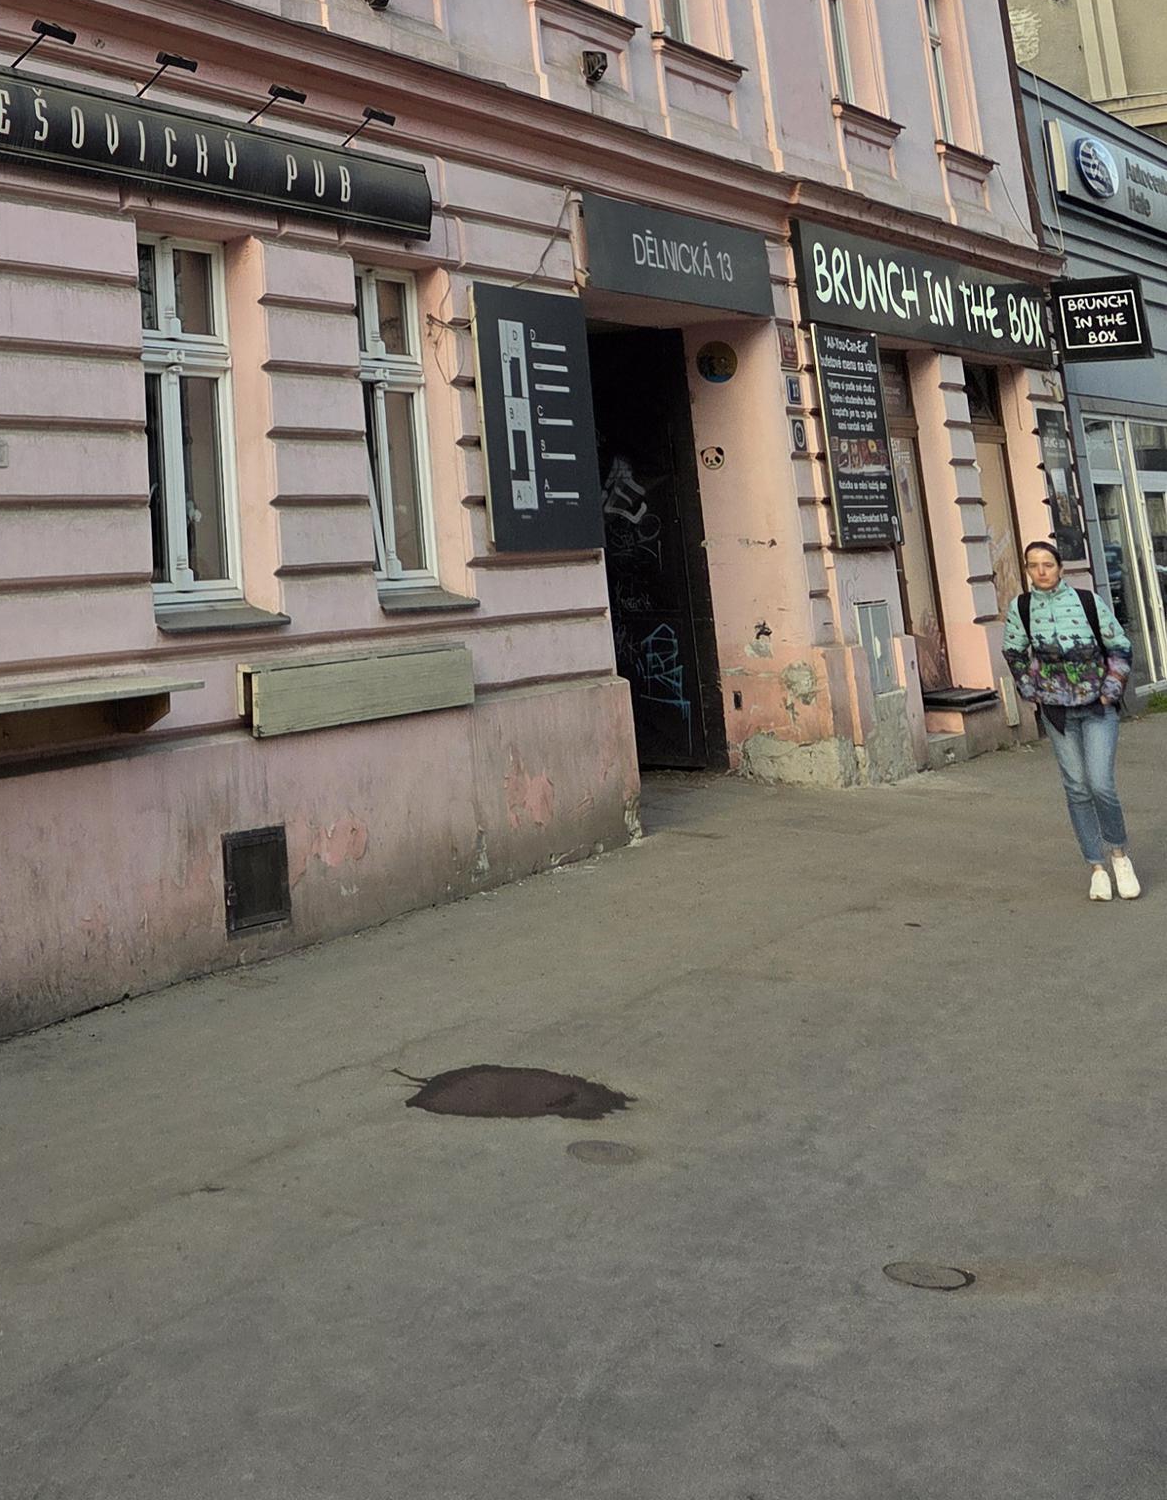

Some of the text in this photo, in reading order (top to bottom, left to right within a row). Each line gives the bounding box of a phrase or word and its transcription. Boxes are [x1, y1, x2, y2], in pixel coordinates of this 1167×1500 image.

[286, 153, 351, 202] PUB
[632, 229, 733, 282] DĚLNICKÁ 13
[813, 242, 1046, 348] BRUNCH IN THE BOX
[1067, 294, 1128, 311] BRUNCH
[1073, 312, 1127, 329] IN THE
[1088, 329, 1118, 344] BOX
[536, 404, 544, 417] C
[544, 478, 551, 490] A
